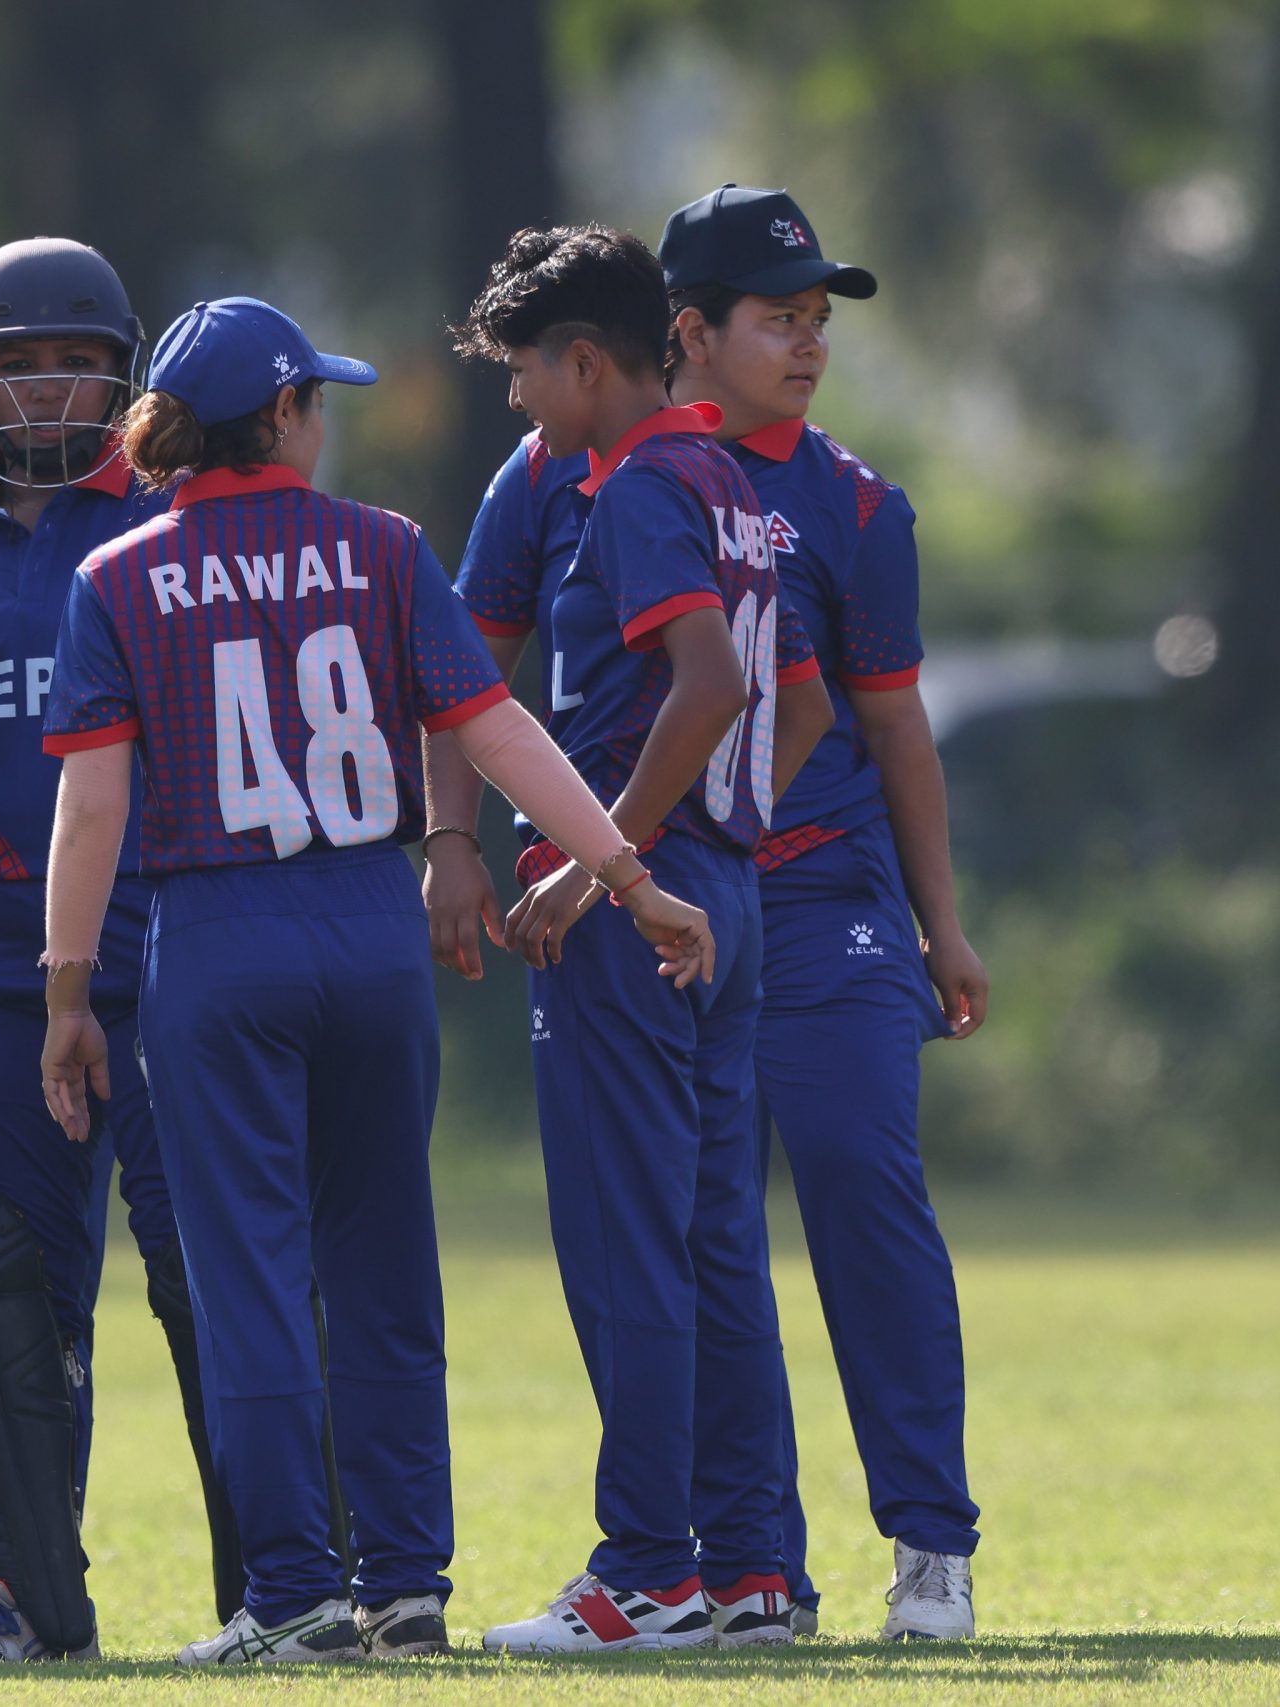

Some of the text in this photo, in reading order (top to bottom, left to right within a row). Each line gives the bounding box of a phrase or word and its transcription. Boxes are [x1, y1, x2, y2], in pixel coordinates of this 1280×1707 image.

[275, 365, 300, 386] KELME
[148, 540, 369, 615] RAWAL
[212, 624, 399, 861] 48
[847, 946, 884, 956] KELME
